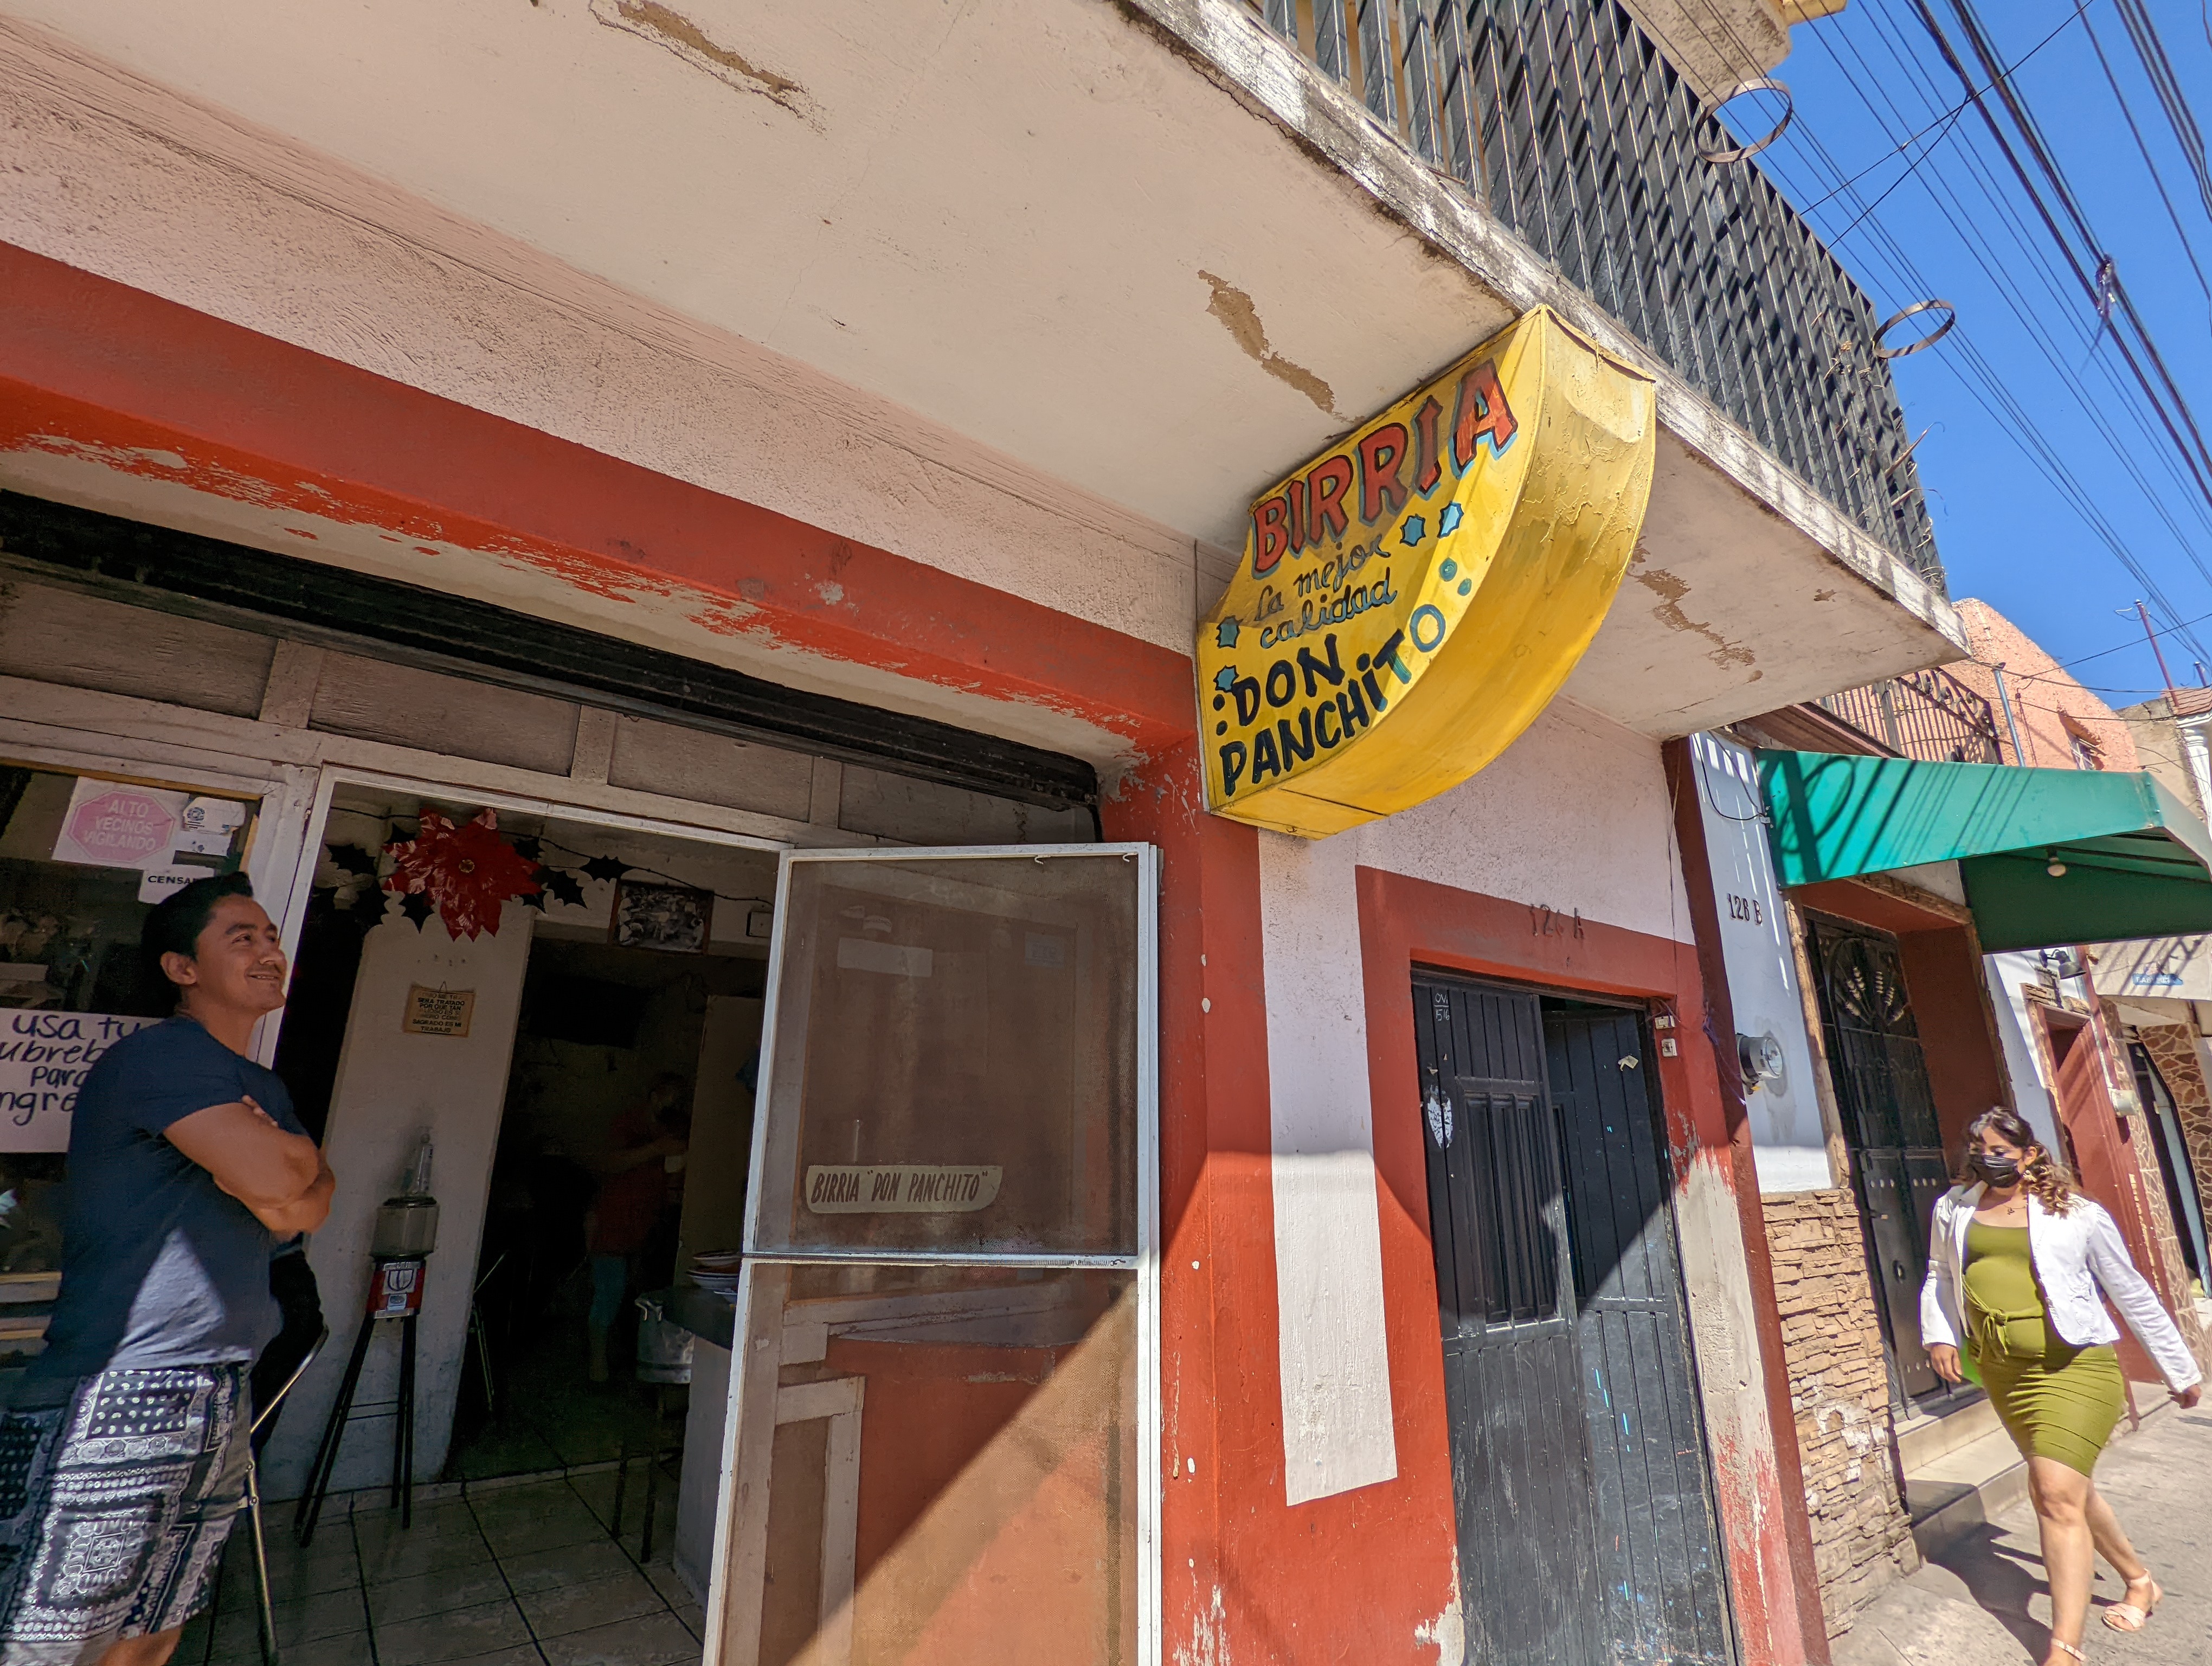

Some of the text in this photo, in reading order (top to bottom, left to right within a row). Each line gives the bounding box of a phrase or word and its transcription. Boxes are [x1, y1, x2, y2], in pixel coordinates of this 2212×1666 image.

[1252, 357, 1518, 579] BIRRIA
[1293, 534, 1391, 597] mejor
[1260, 567, 1398, 649] calidad
[1231, 633, 1345, 726] DON
[108, 799, 149, 817] ALTO
[83, 830, 156, 851] VIGILANDO
[95, 816, 155, 835] VECINOS
[1727, 893, 1763, 925] 126 B
[12, 1014, 86, 1040] usa
[811, 1172, 860, 1204] BIRRIA
